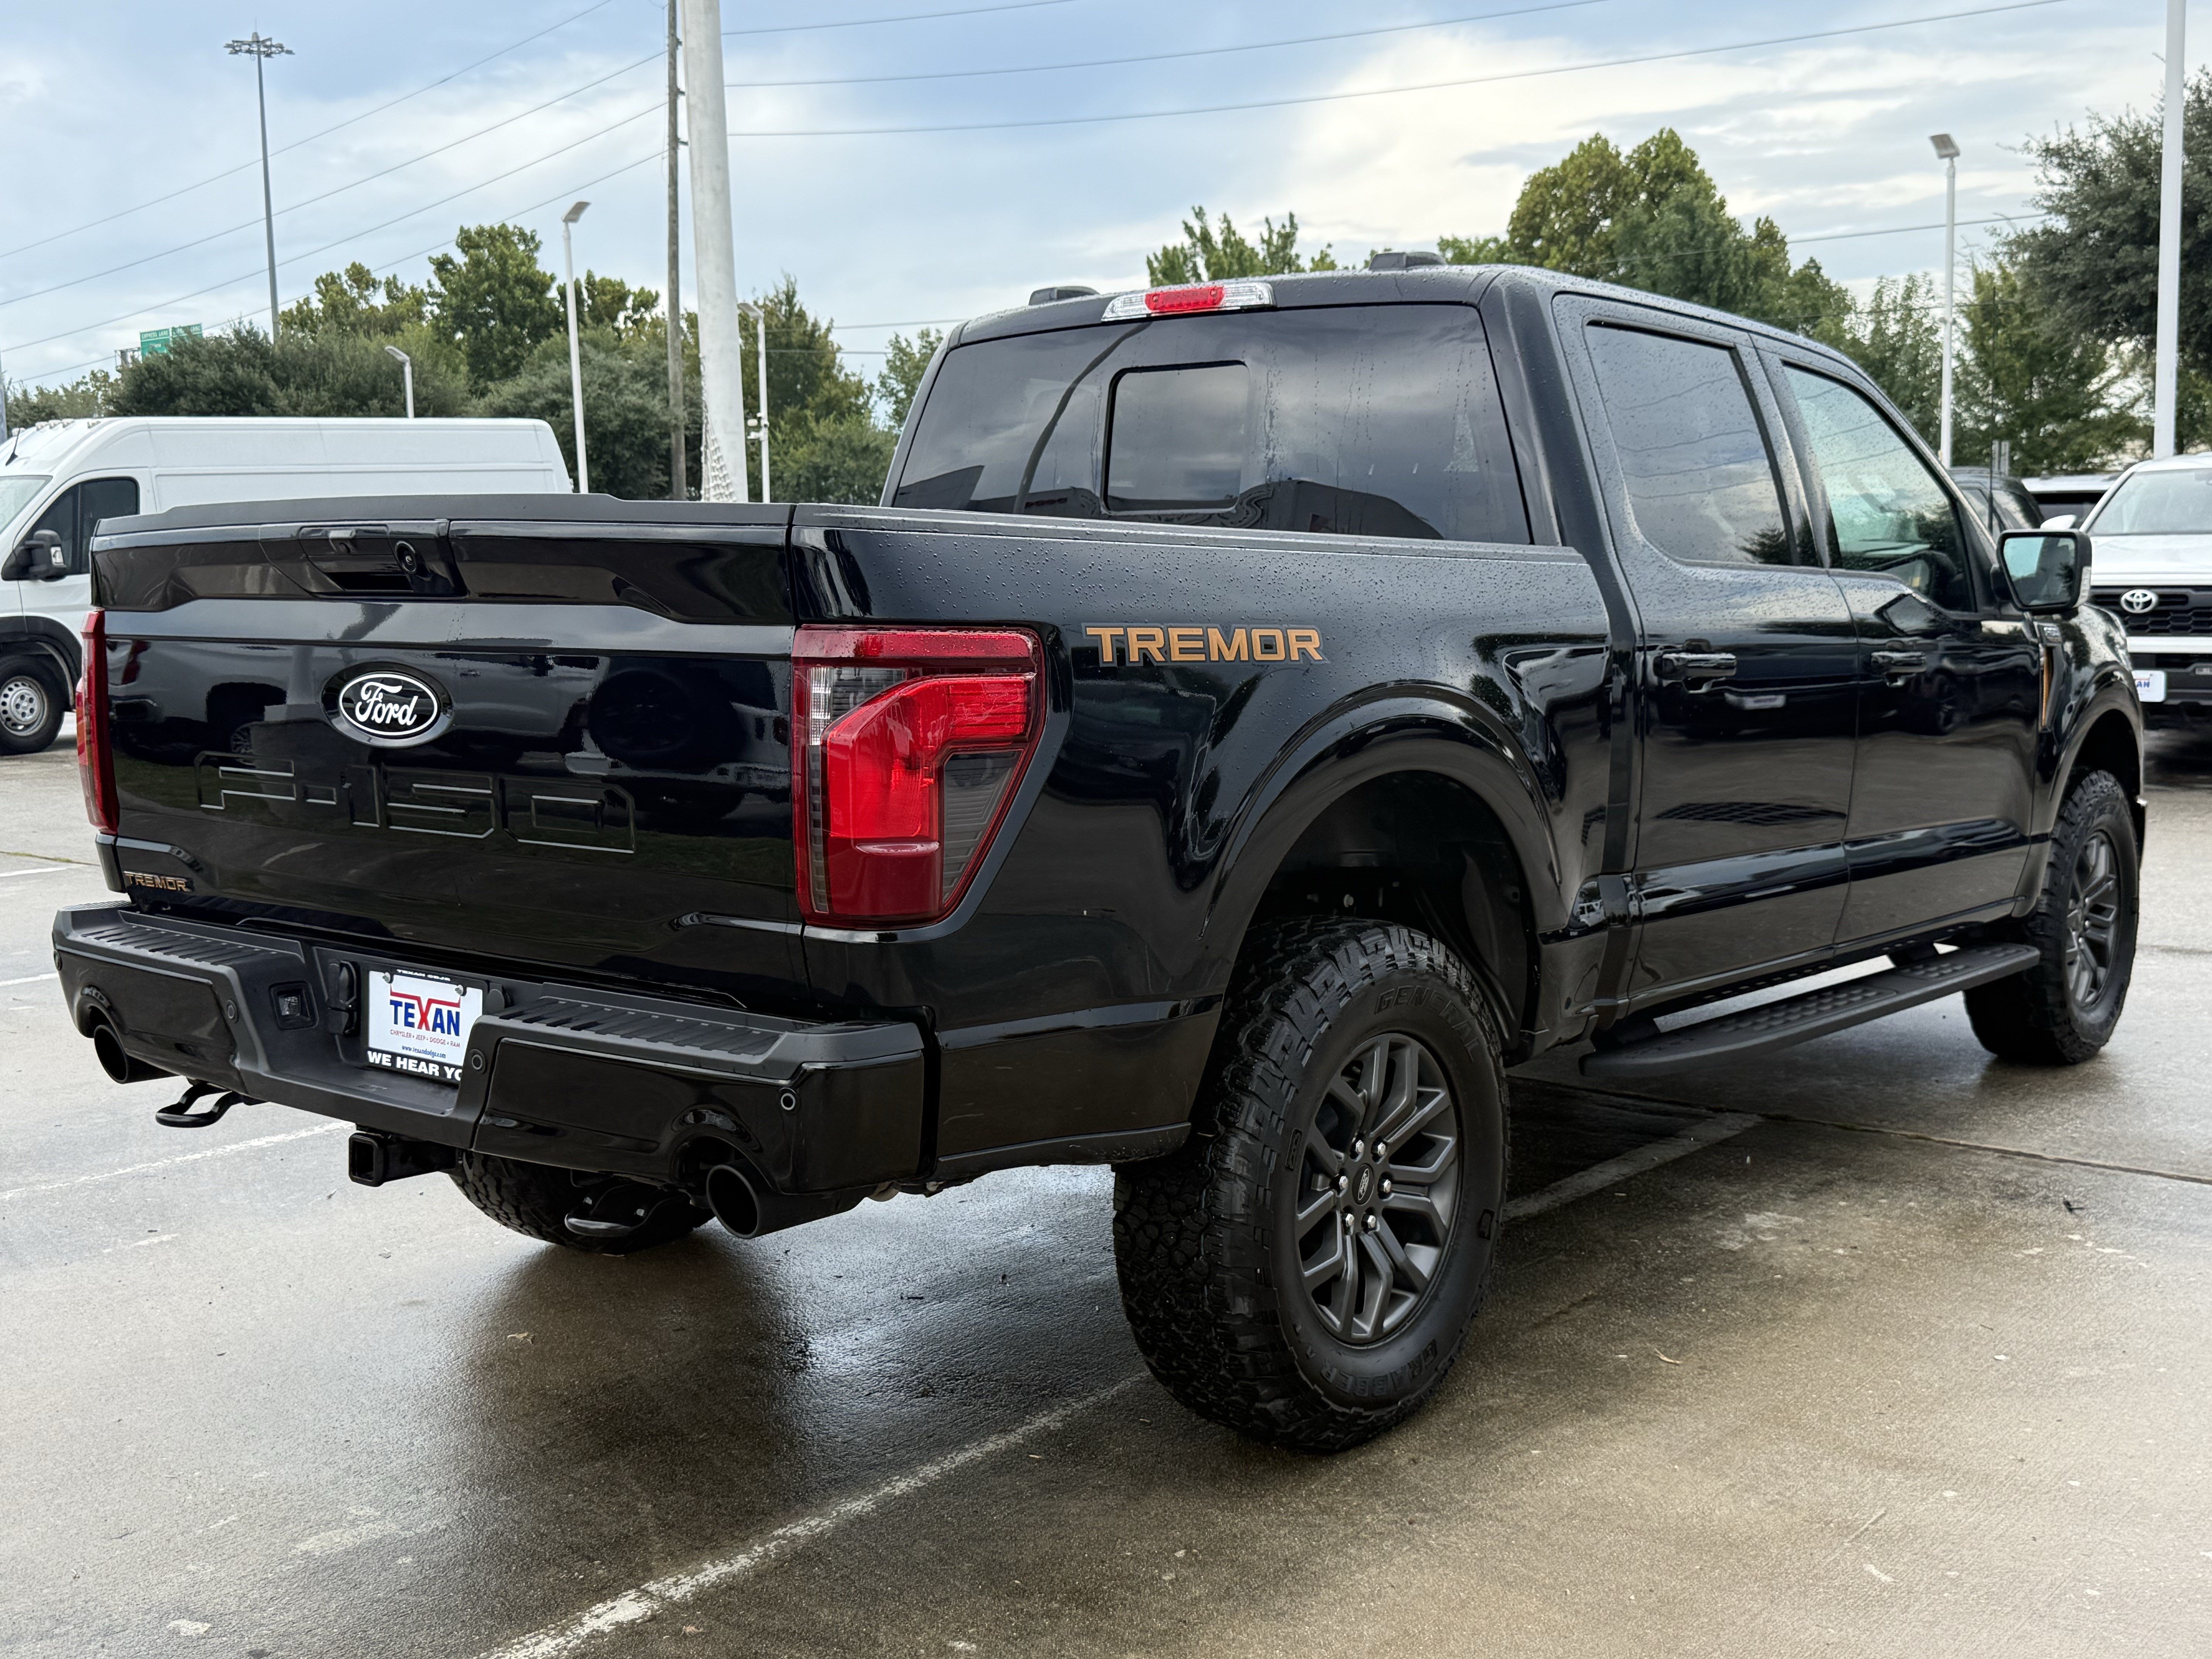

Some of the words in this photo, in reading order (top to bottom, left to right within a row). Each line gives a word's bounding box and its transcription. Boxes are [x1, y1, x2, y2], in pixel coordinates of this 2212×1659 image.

[1085, 625, 1325, 663] TREMOR
[355, 682, 419, 726] Ford
[195, 750, 634, 854] F-150
[124, 871, 192, 892] TREMOR
[397, 969, 426, 977] TEXAN
[389, 996, 460, 1037] TEXAN
[1374, 985, 1480, 1063] GENERAL
[390, 1029, 412, 1038] CHRYSLER
[429, 1037, 446, 1045] DODGE
[367, 1051, 392, 1066] WE
[396, 1056, 440, 1076] HEAR
[1319, 1338, 1438, 1398] GRABBER
